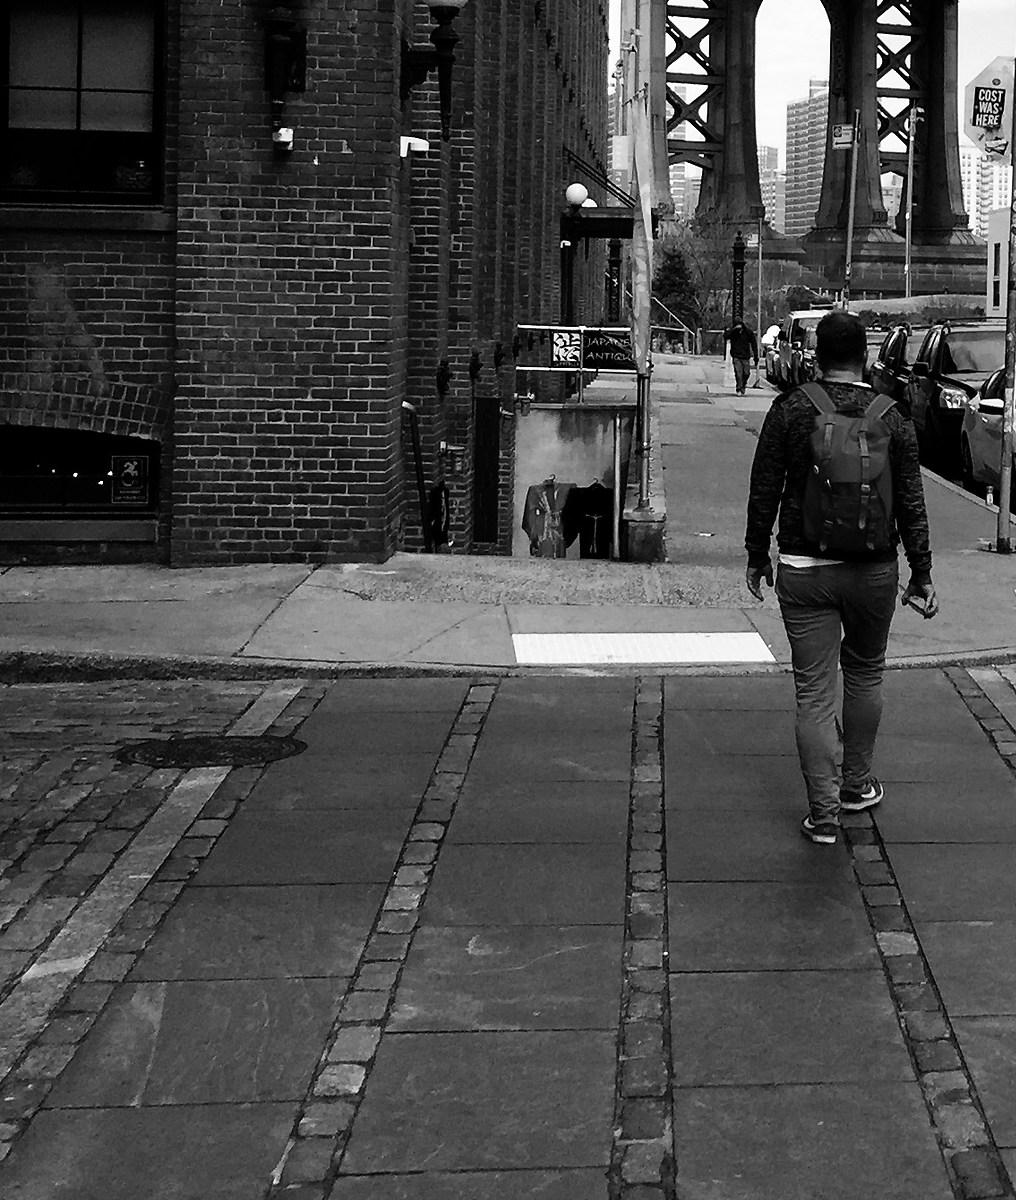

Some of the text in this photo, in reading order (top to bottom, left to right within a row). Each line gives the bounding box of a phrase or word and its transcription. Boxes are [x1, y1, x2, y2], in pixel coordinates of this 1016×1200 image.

[978, 88, 1004, 102] COST
[979, 101, 1000, 114] WAS
[975, 113, 1000, 126] HERE
[585, 351, 633, 361] ANTIQU
